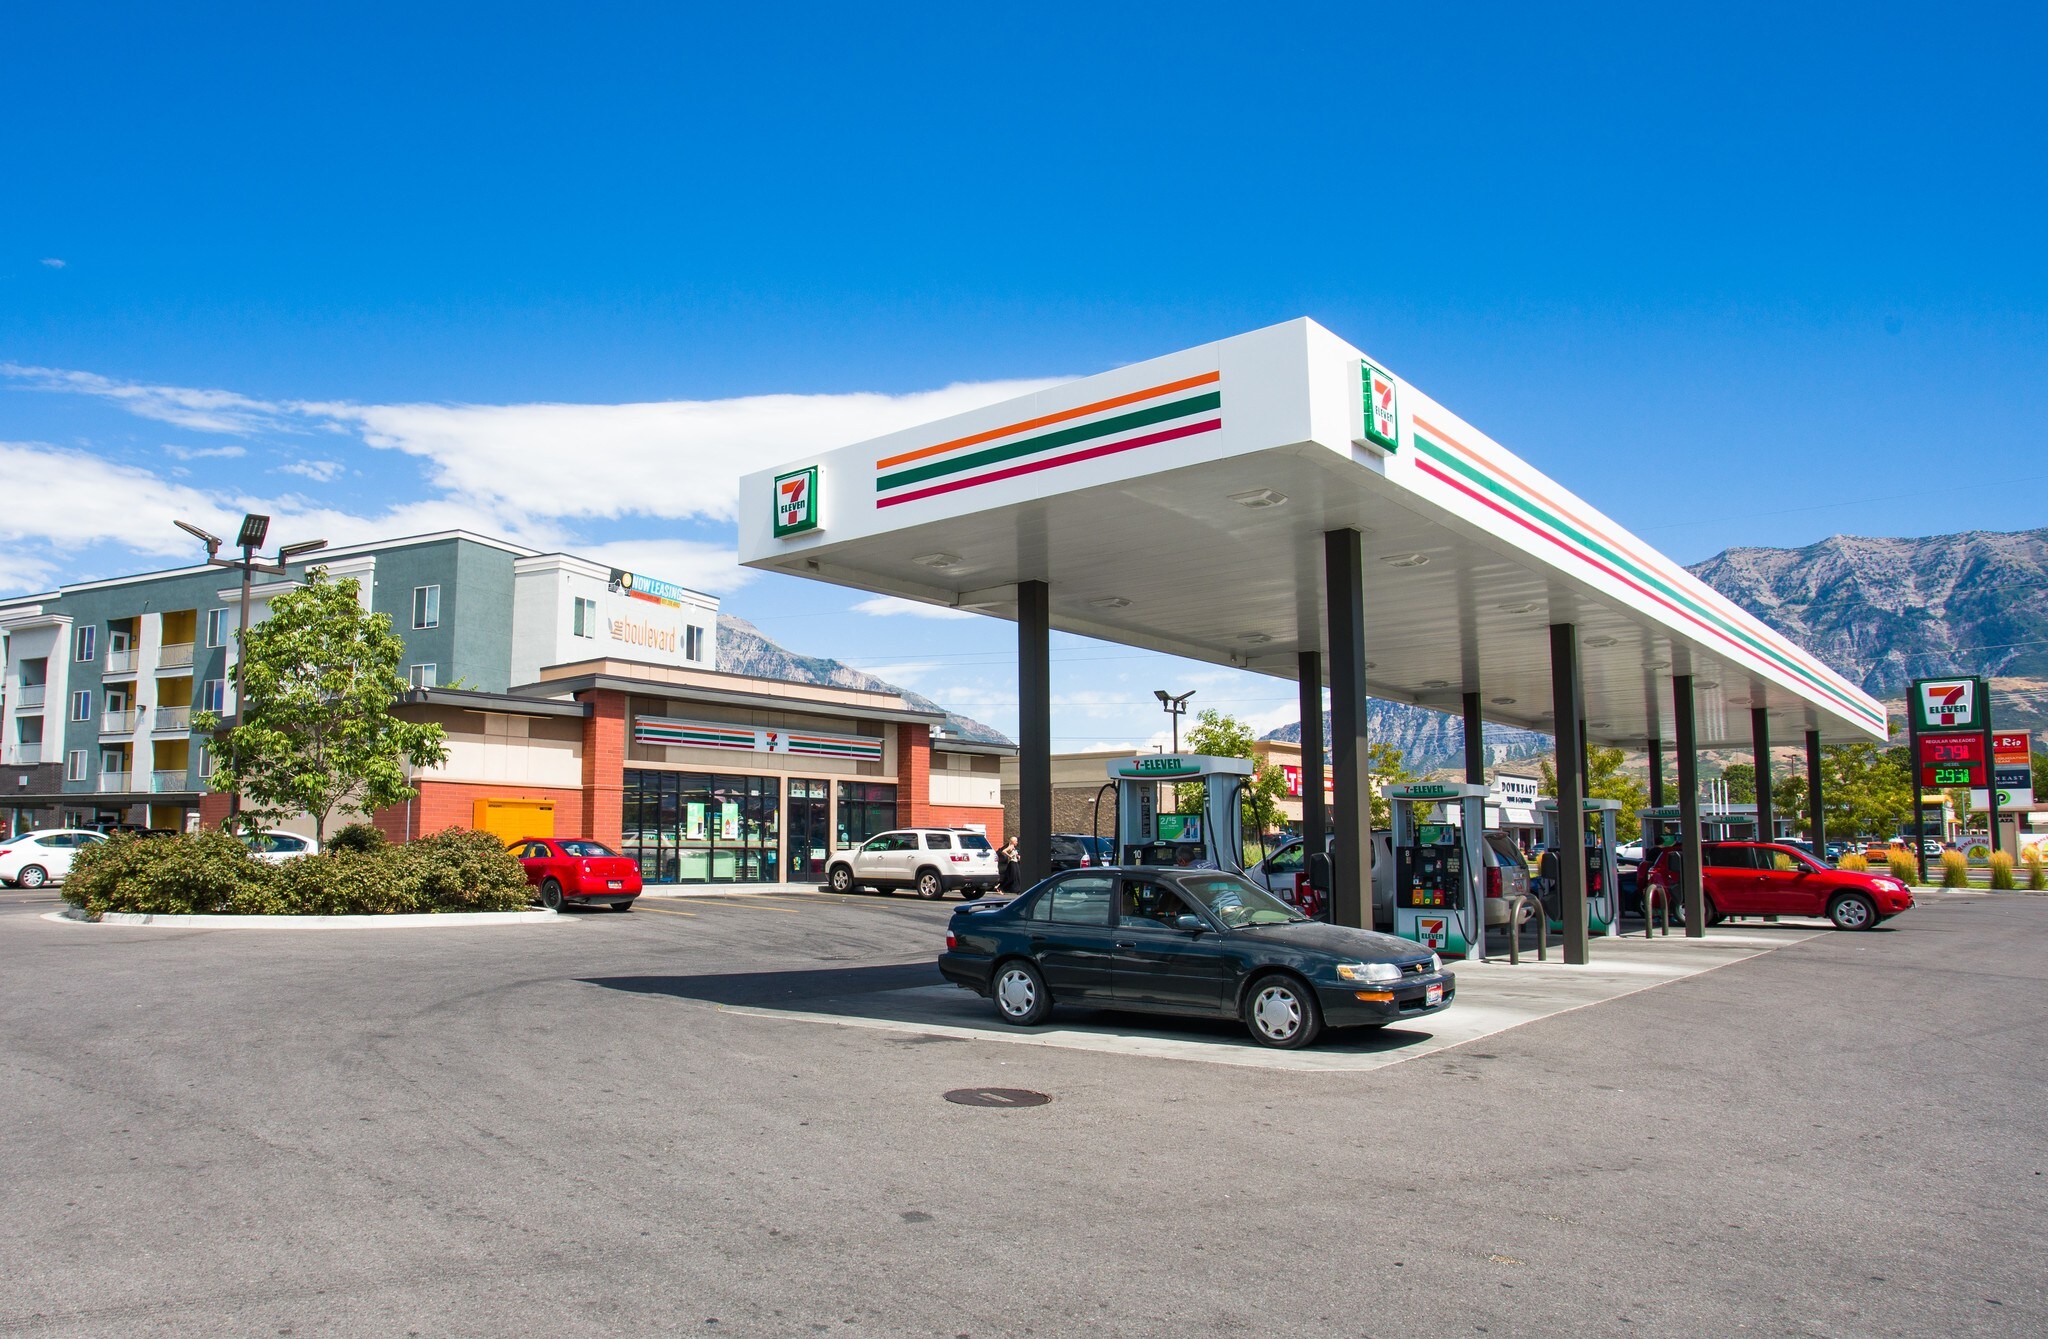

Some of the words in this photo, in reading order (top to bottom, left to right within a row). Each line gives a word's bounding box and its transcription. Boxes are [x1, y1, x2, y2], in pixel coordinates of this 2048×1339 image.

[782, 478, 805, 525] 7
[632, 574, 651, 593] NOW
[651, 581, 682, 600] LEASING
[624, 614, 676, 653] boulevard
[1929, 685, 1965, 725] 7
[1133, 849, 1142, 859] 10
